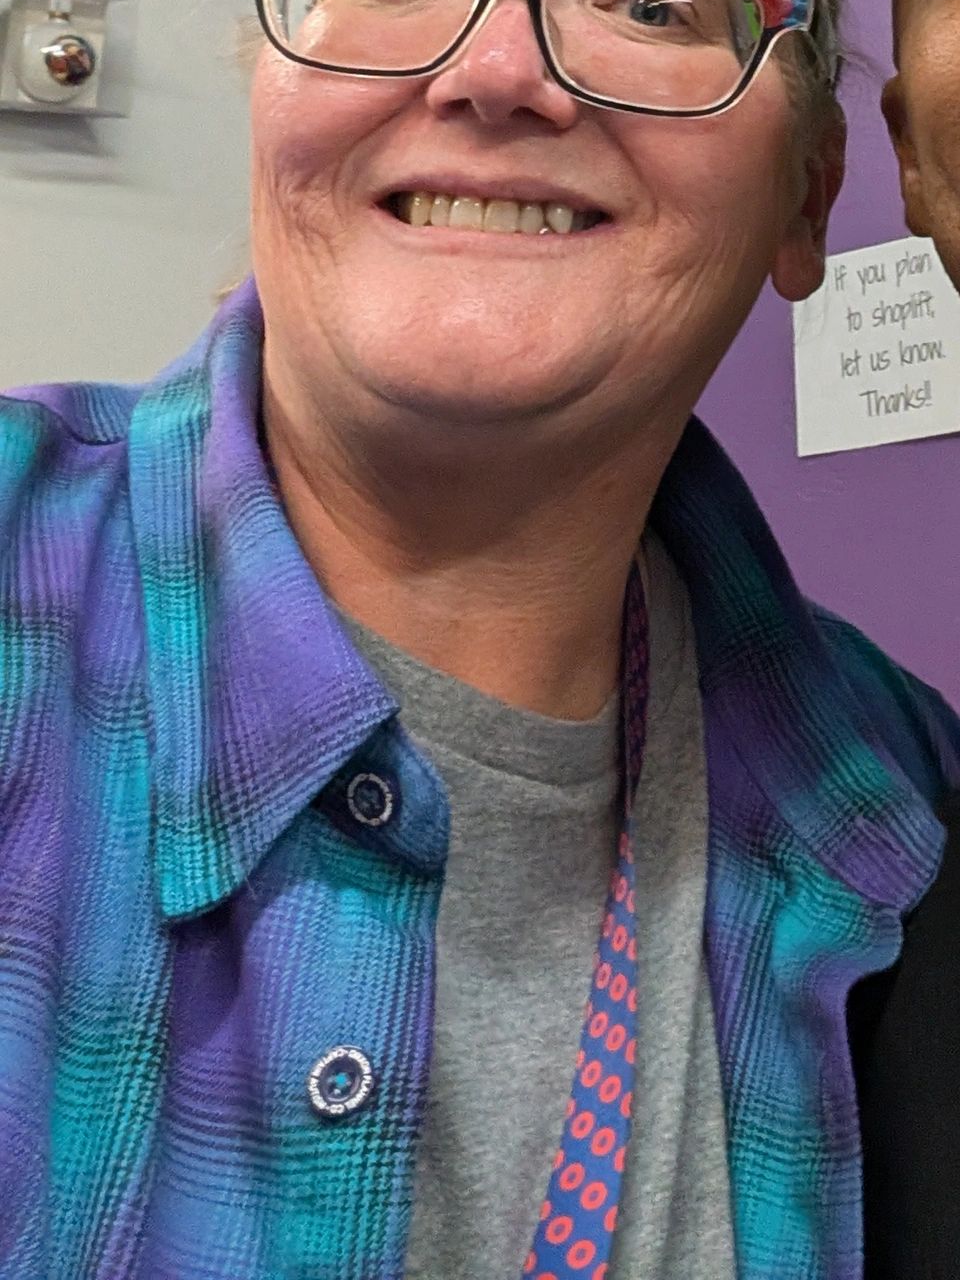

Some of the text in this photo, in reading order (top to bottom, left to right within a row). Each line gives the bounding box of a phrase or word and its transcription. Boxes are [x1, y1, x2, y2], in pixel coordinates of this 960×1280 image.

[856, 263, 886, 295] you
[896, 251, 932, 288] plan
[846, 306, 863, 332] to
[840, 349, 862, 378] let
[870, 350, 891, 372] us
